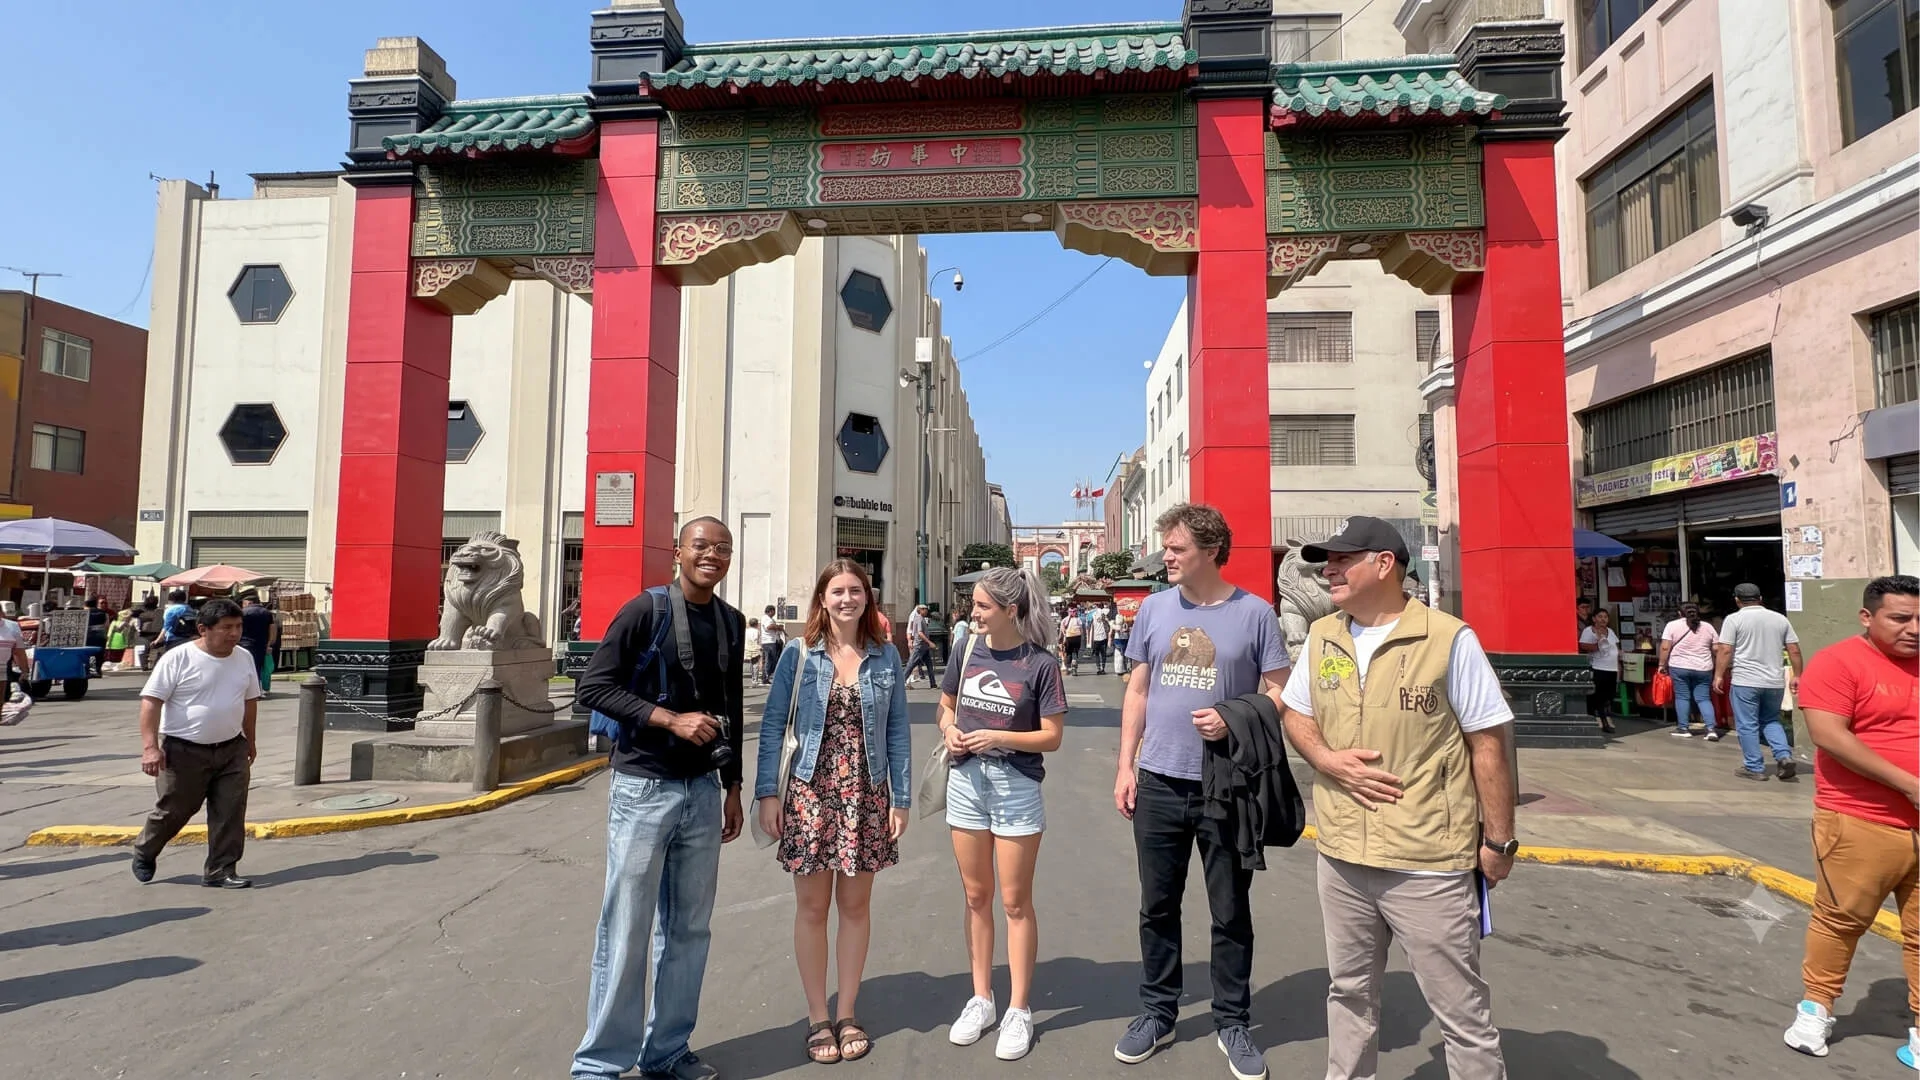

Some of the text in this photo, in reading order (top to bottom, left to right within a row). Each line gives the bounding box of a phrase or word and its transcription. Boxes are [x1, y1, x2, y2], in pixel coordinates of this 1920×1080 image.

[850, 496, 879, 511] bubble
[1200, 667, 1218, 678] ME
[1160, 673, 1216, 690] COFFEE?
